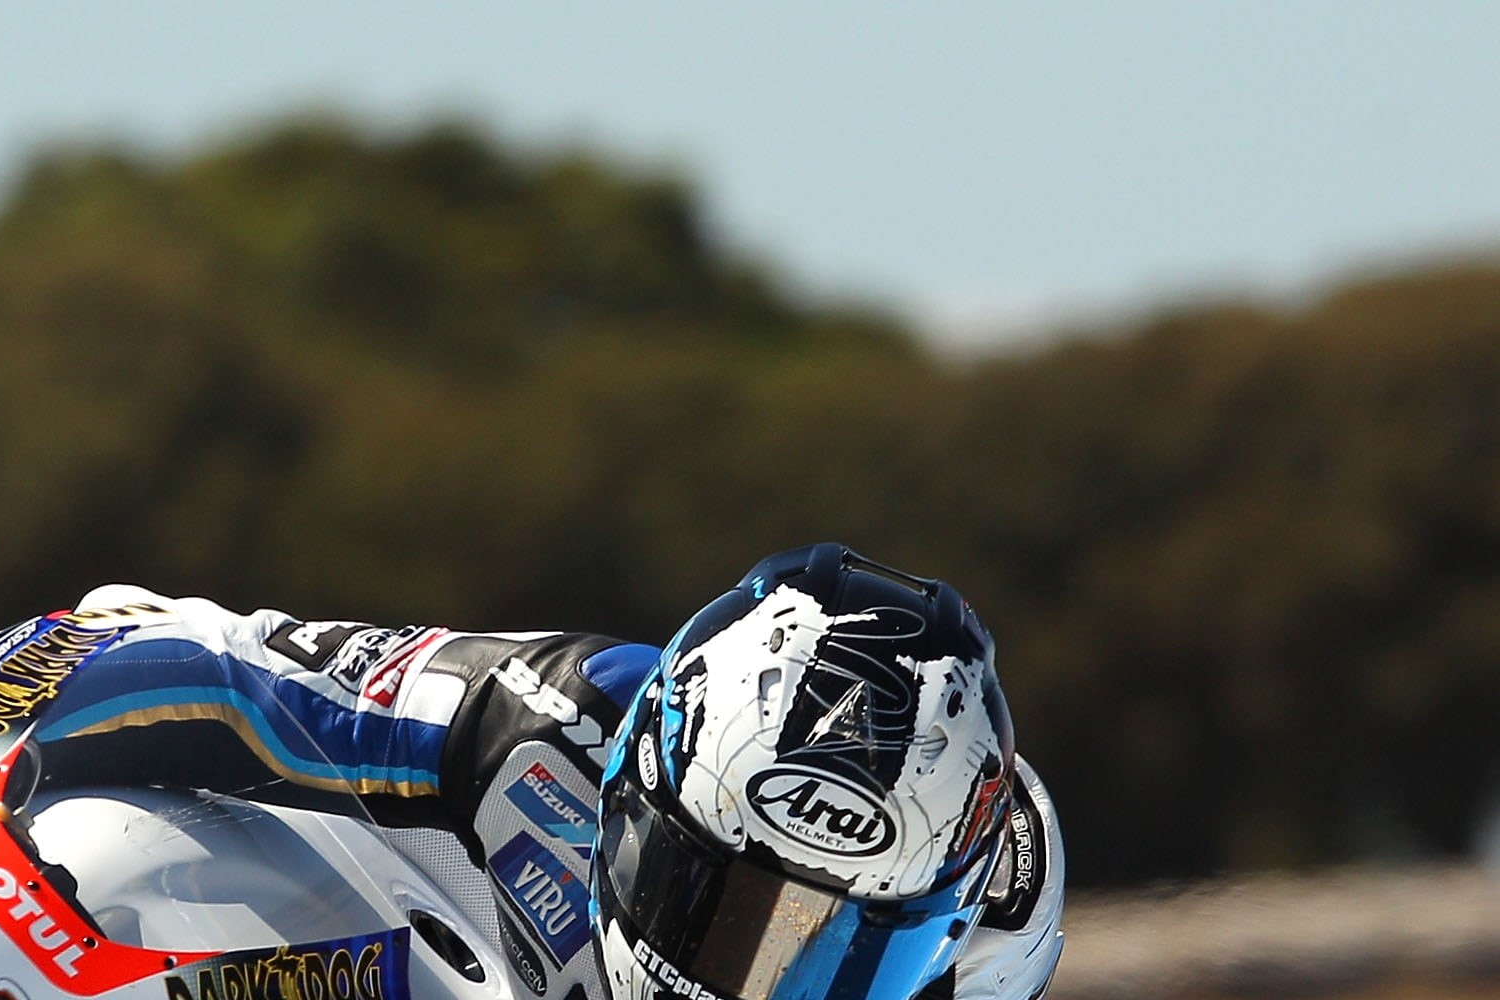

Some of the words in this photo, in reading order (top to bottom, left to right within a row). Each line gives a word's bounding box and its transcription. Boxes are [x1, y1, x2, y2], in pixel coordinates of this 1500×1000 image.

[640, 738, 655, 786] Arai
[522, 772, 587, 828] SUZUKI
[752, 779, 883, 844] Arai
[786, 821, 842, 847] HELMET
[1011, 807, 1033, 890] BACK
[513, 860, 577, 936] VIRU
